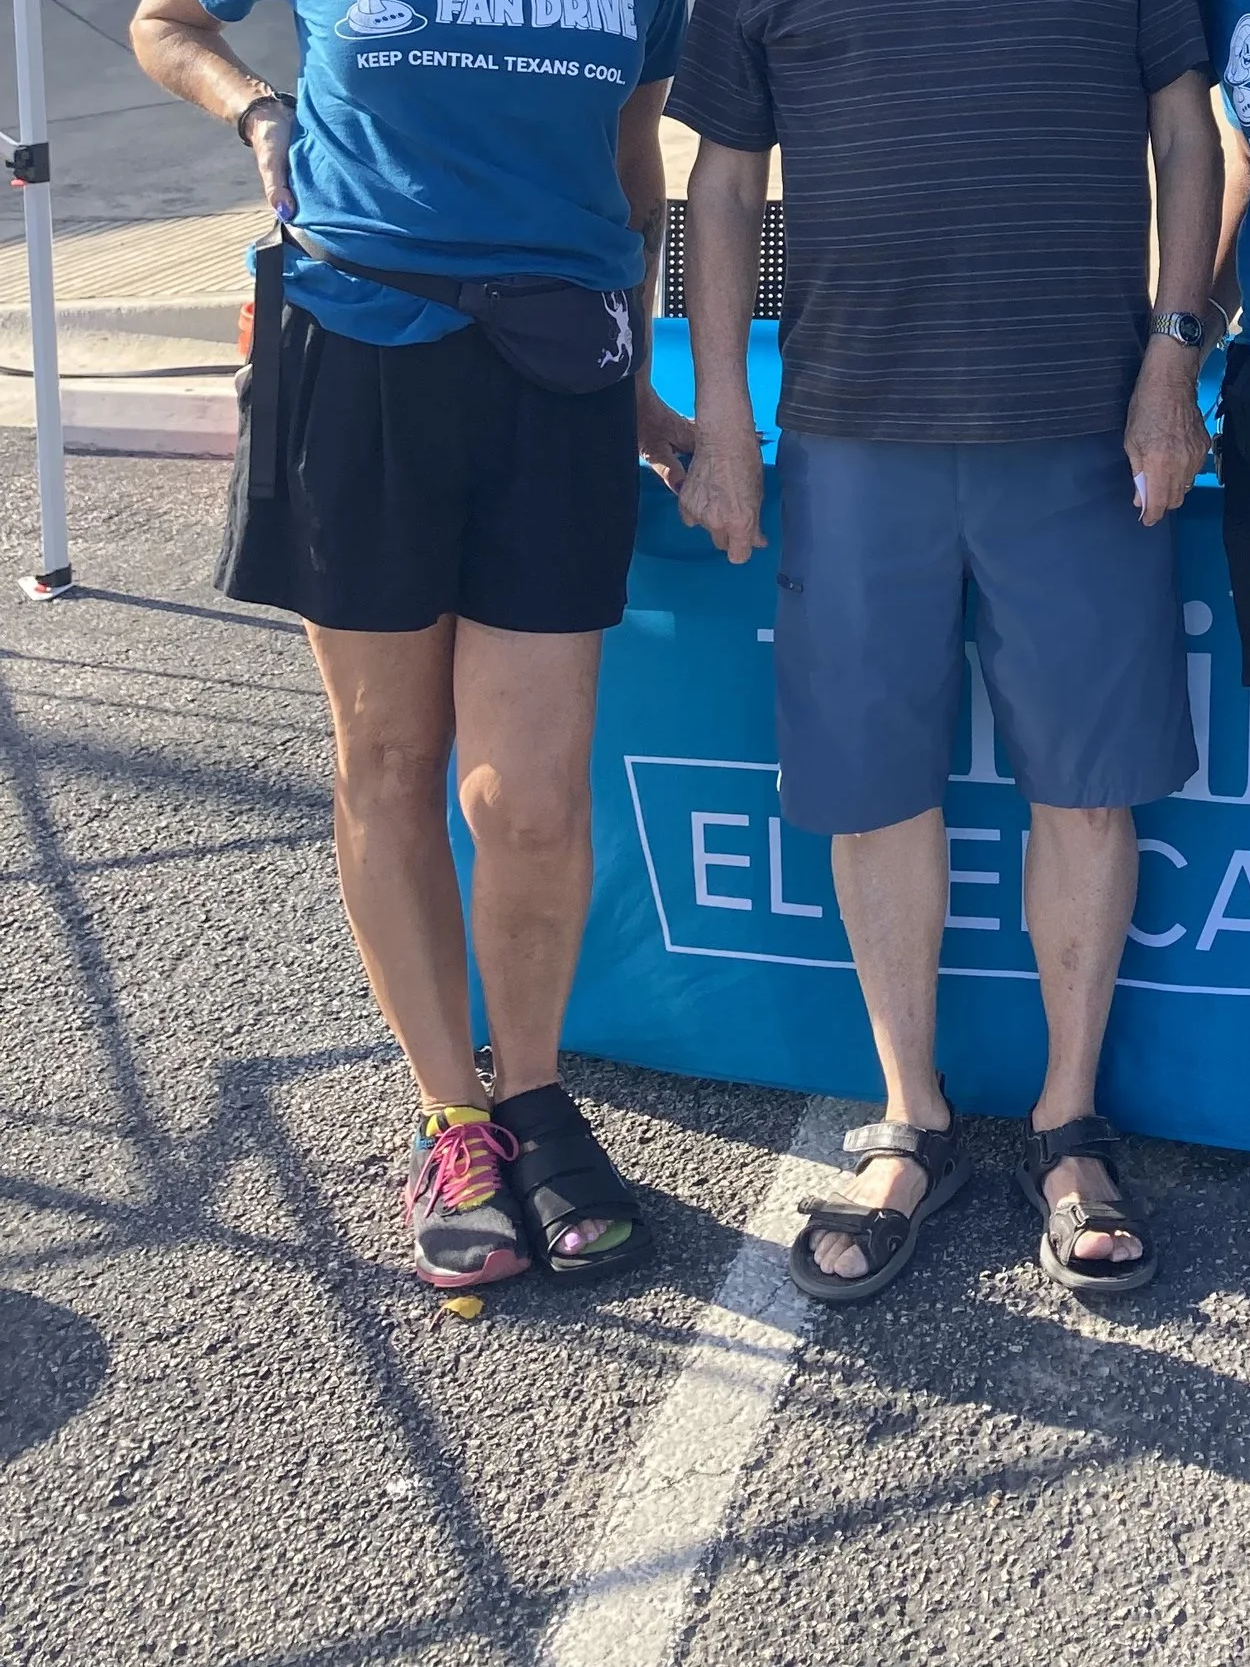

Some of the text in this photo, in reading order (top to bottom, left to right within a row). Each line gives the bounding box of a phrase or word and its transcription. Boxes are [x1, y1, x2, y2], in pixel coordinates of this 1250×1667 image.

[357, 50, 626, 85] KEEP CENTRAL TEXANS COOL.
